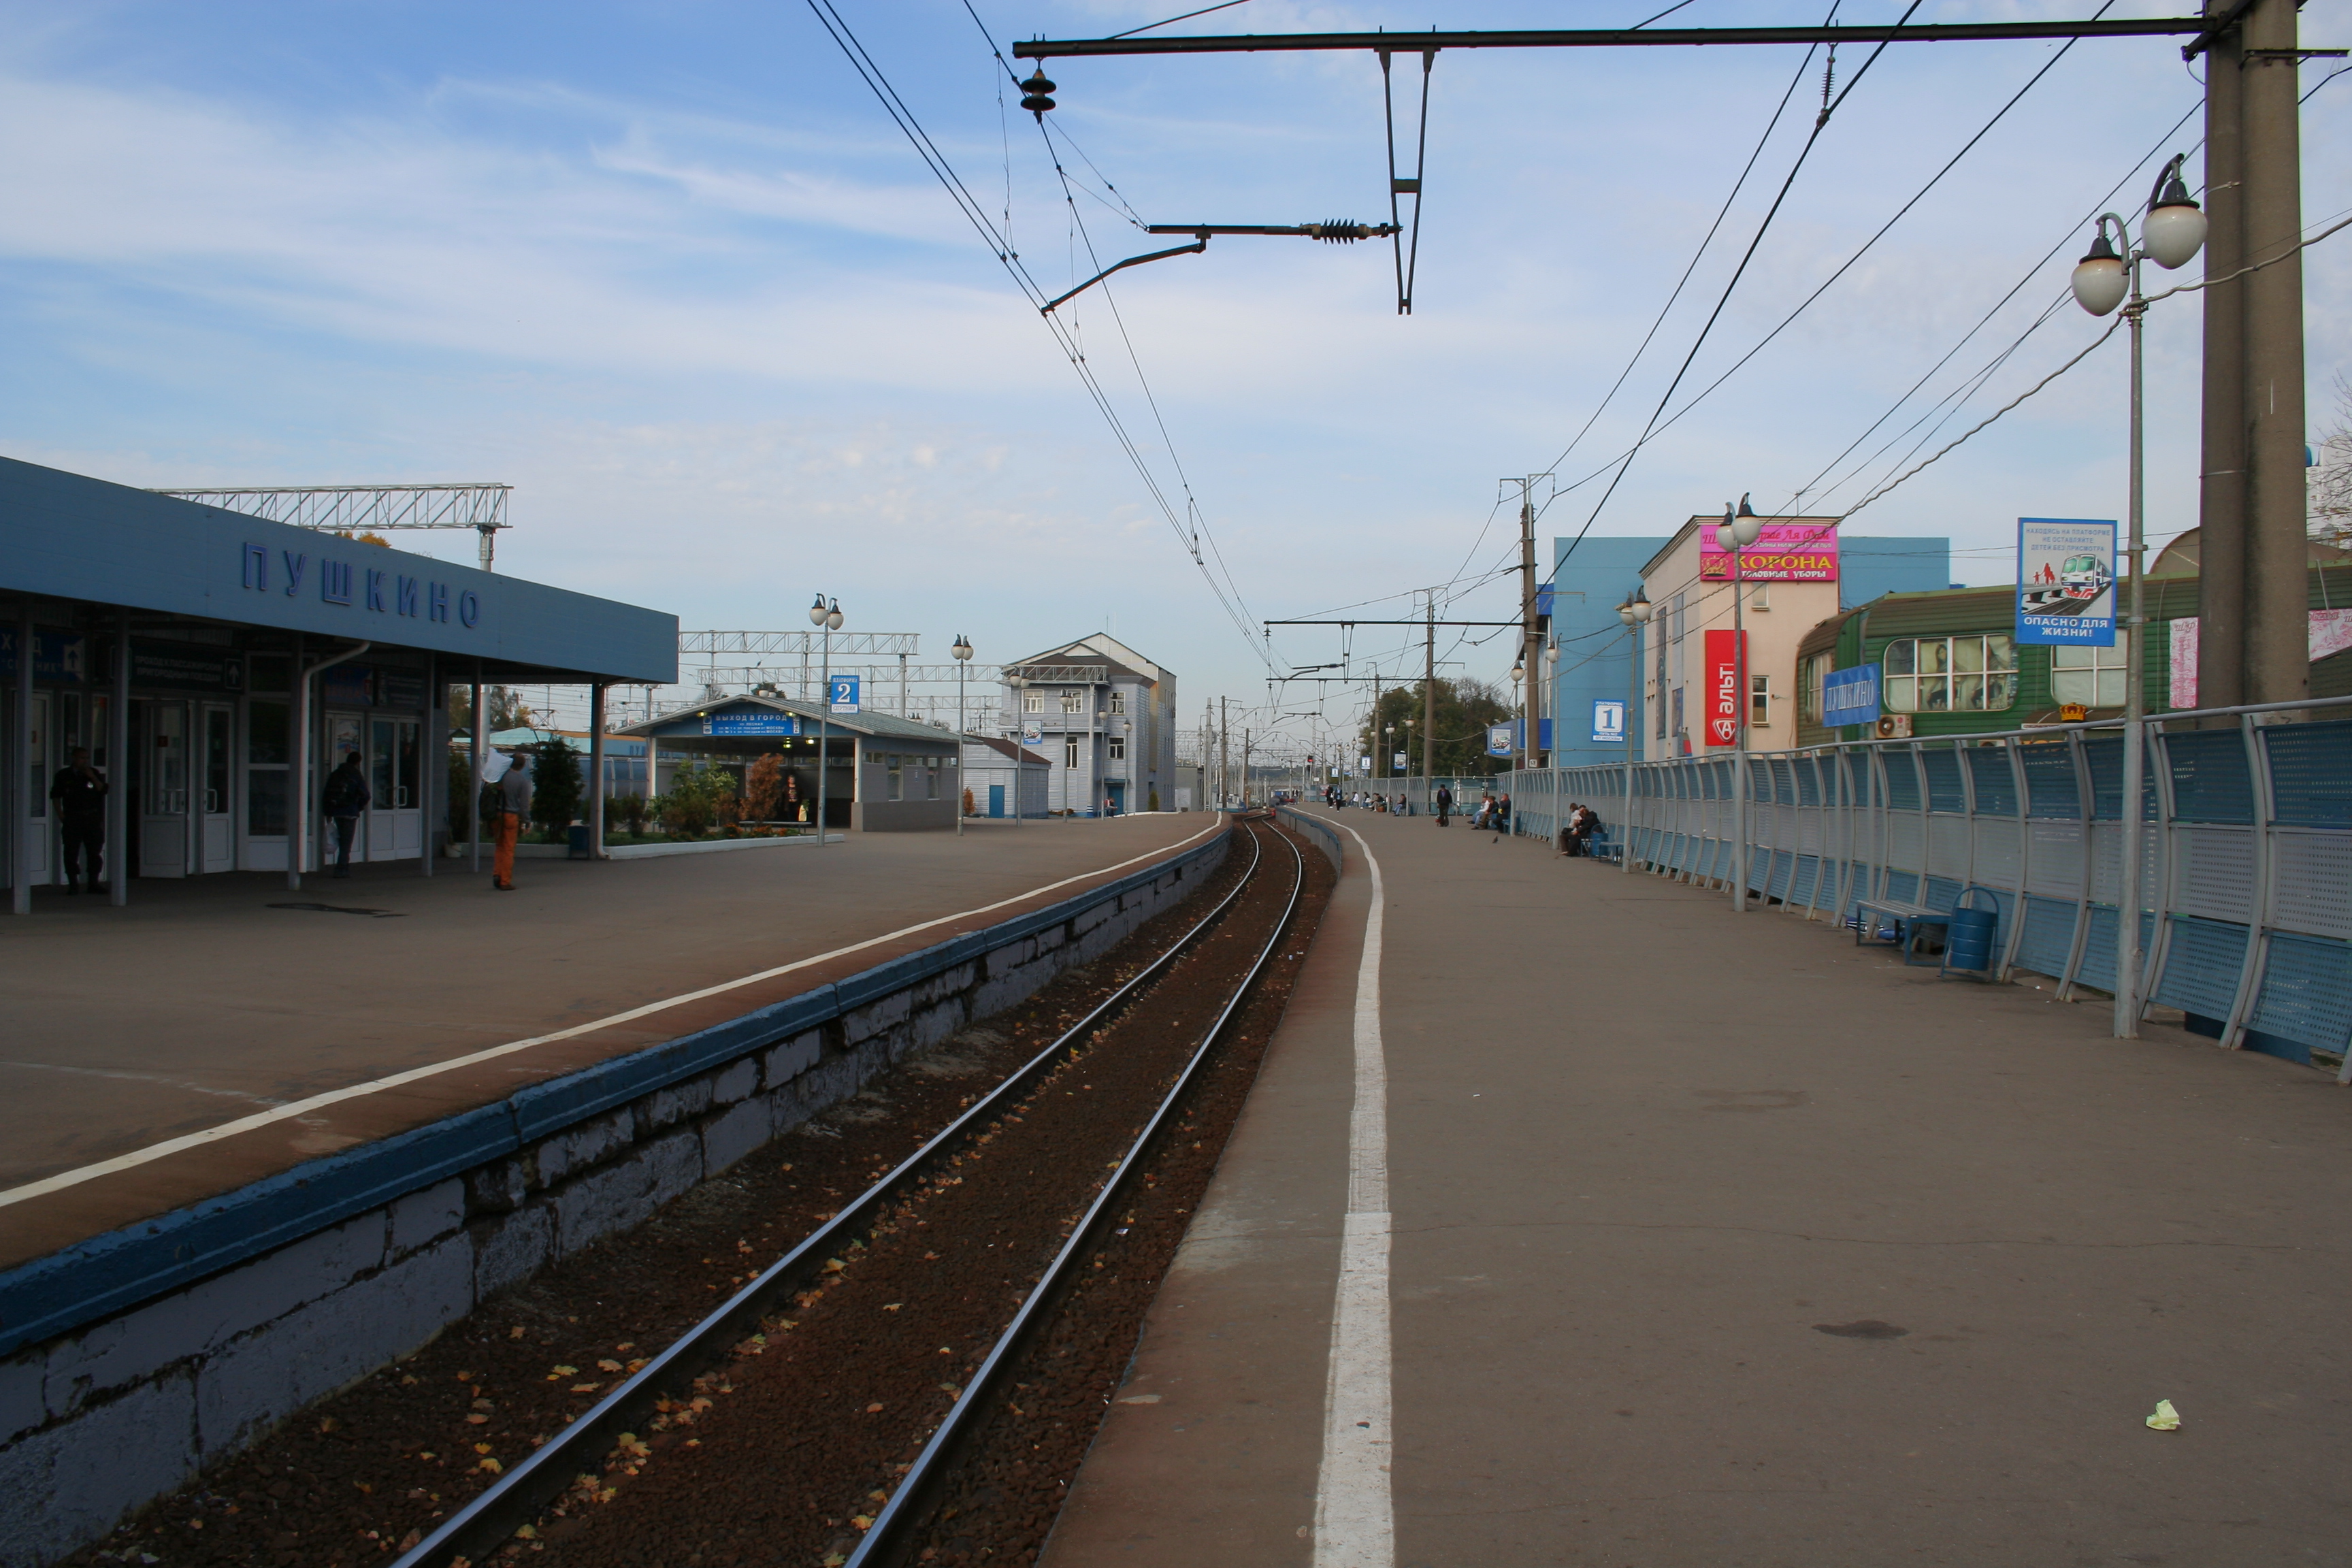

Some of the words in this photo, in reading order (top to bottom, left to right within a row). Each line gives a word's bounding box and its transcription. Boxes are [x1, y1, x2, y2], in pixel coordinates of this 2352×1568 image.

[1793, 570, 1826, 578] УБОРЫ
[244, 542, 479, 628] ПУШКИНО
[2023, 617, 2078, 627] ОПАСНО
[2080, 619, 2108, 628] ДЛЯ
[2042, 627, 2092, 637] ЖИЗНИ!
[836, 683, 851, 703] 2
[1825, 679, 1874, 712] ПУШКИНО
[1603, 708, 1615, 729] 1
